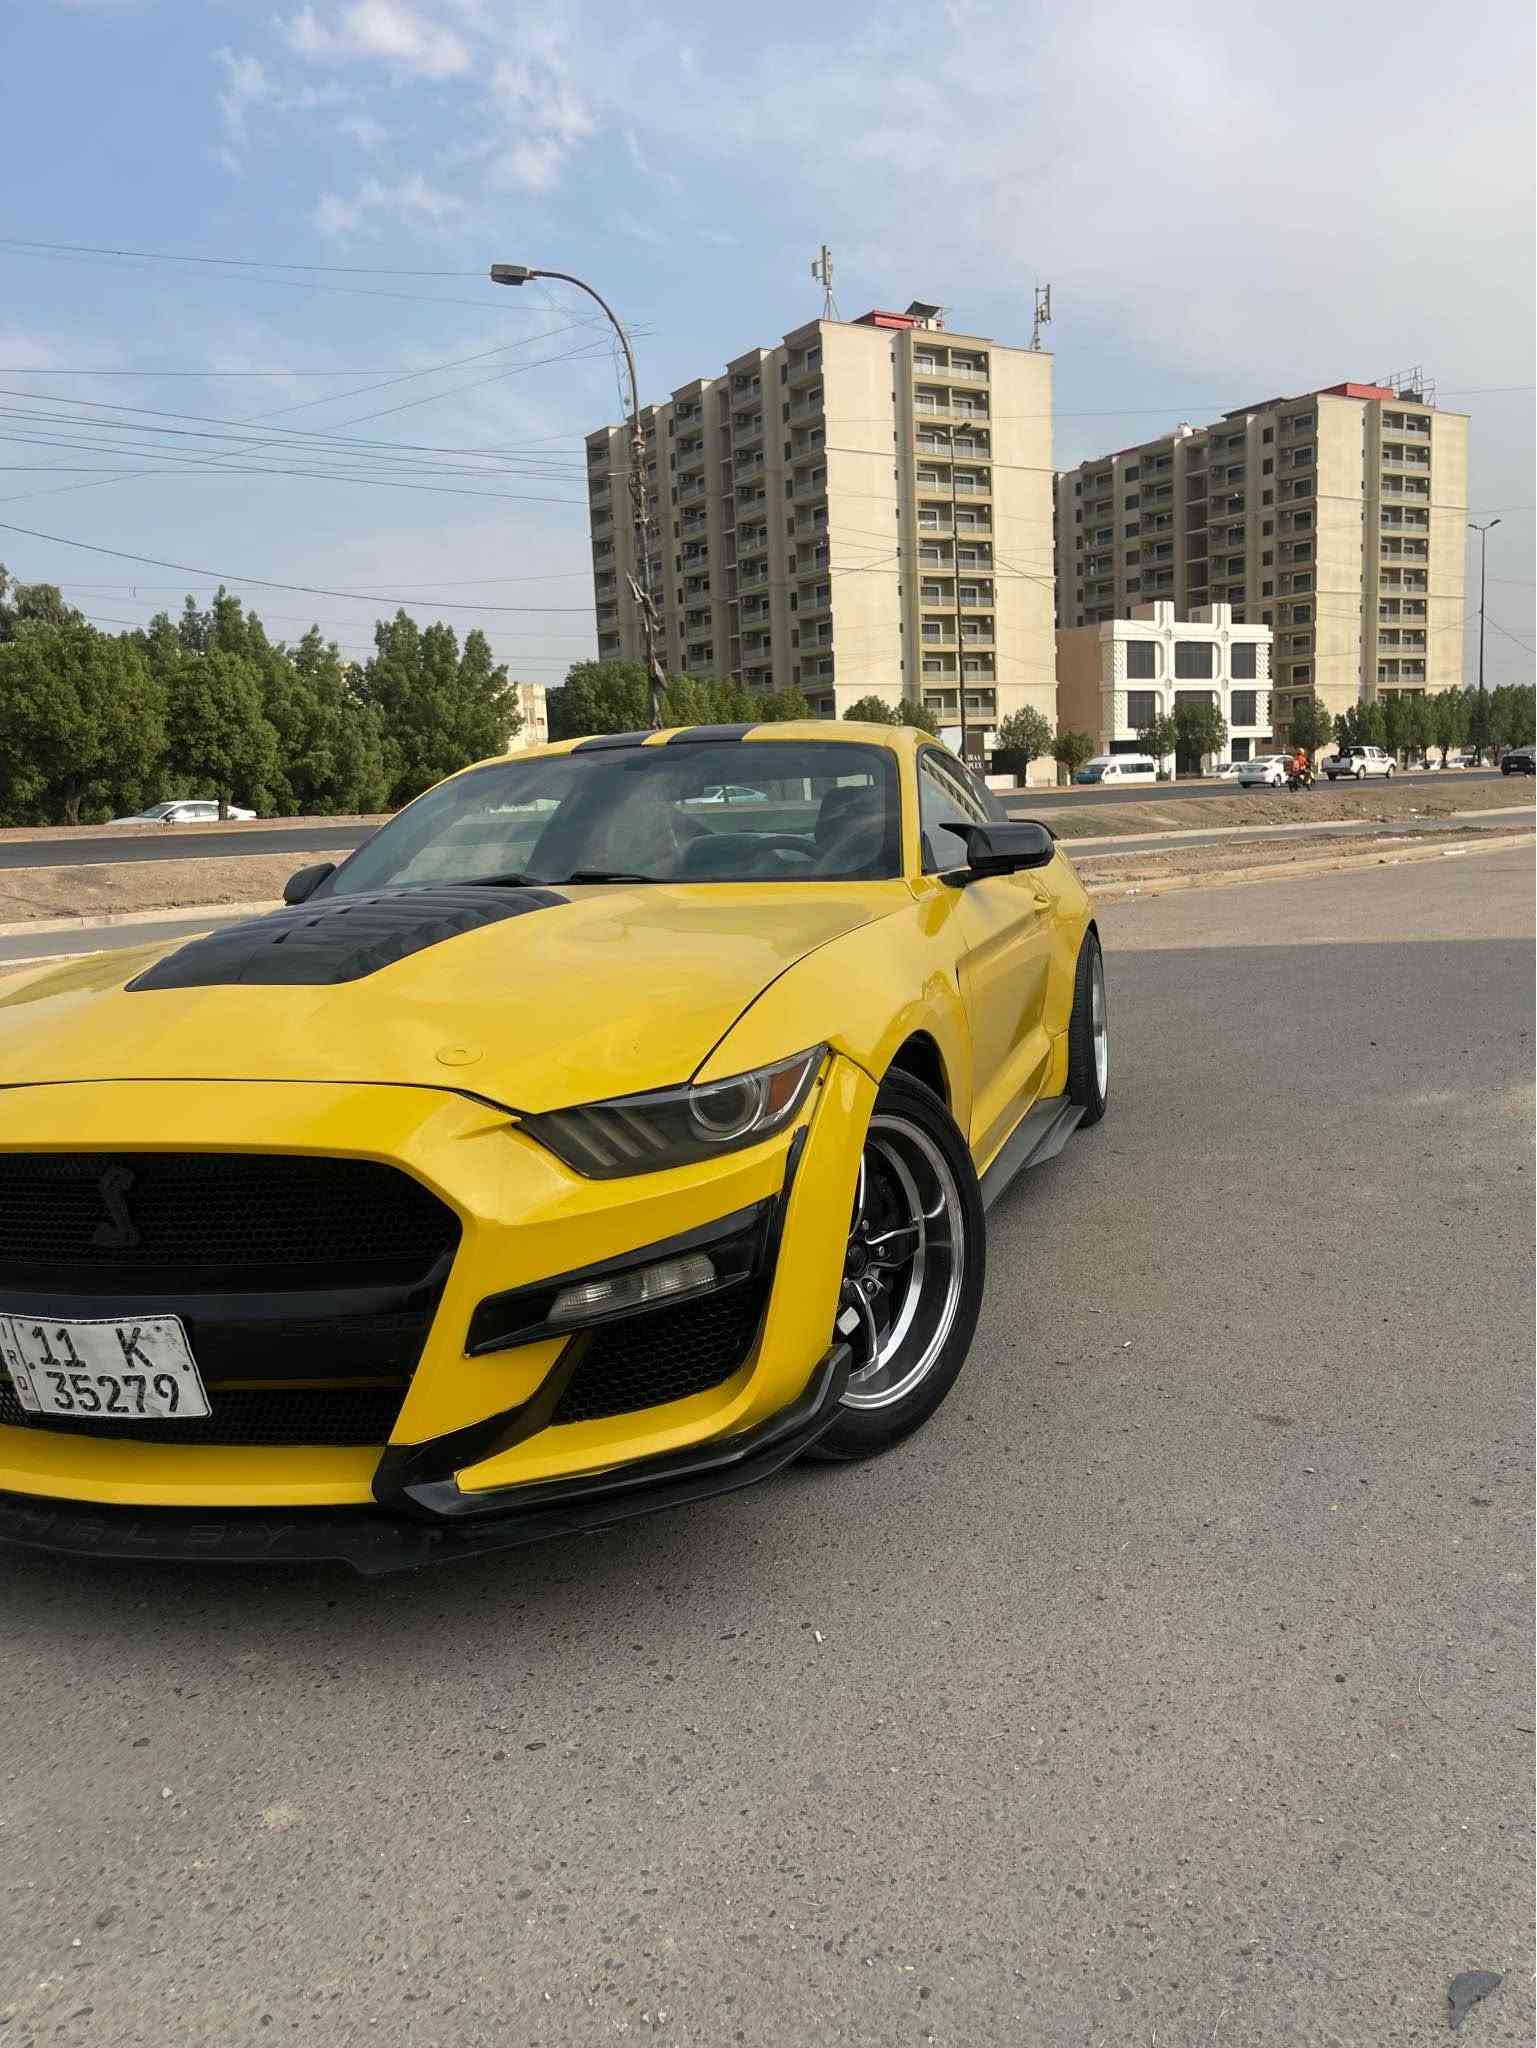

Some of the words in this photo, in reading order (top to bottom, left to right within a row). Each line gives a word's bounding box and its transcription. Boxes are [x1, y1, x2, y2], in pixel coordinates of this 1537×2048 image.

[32, 1326, 87, 1367] 11
[115, 1327, 153, 1368] K
[46, 1371, 180, 1412] 35279
